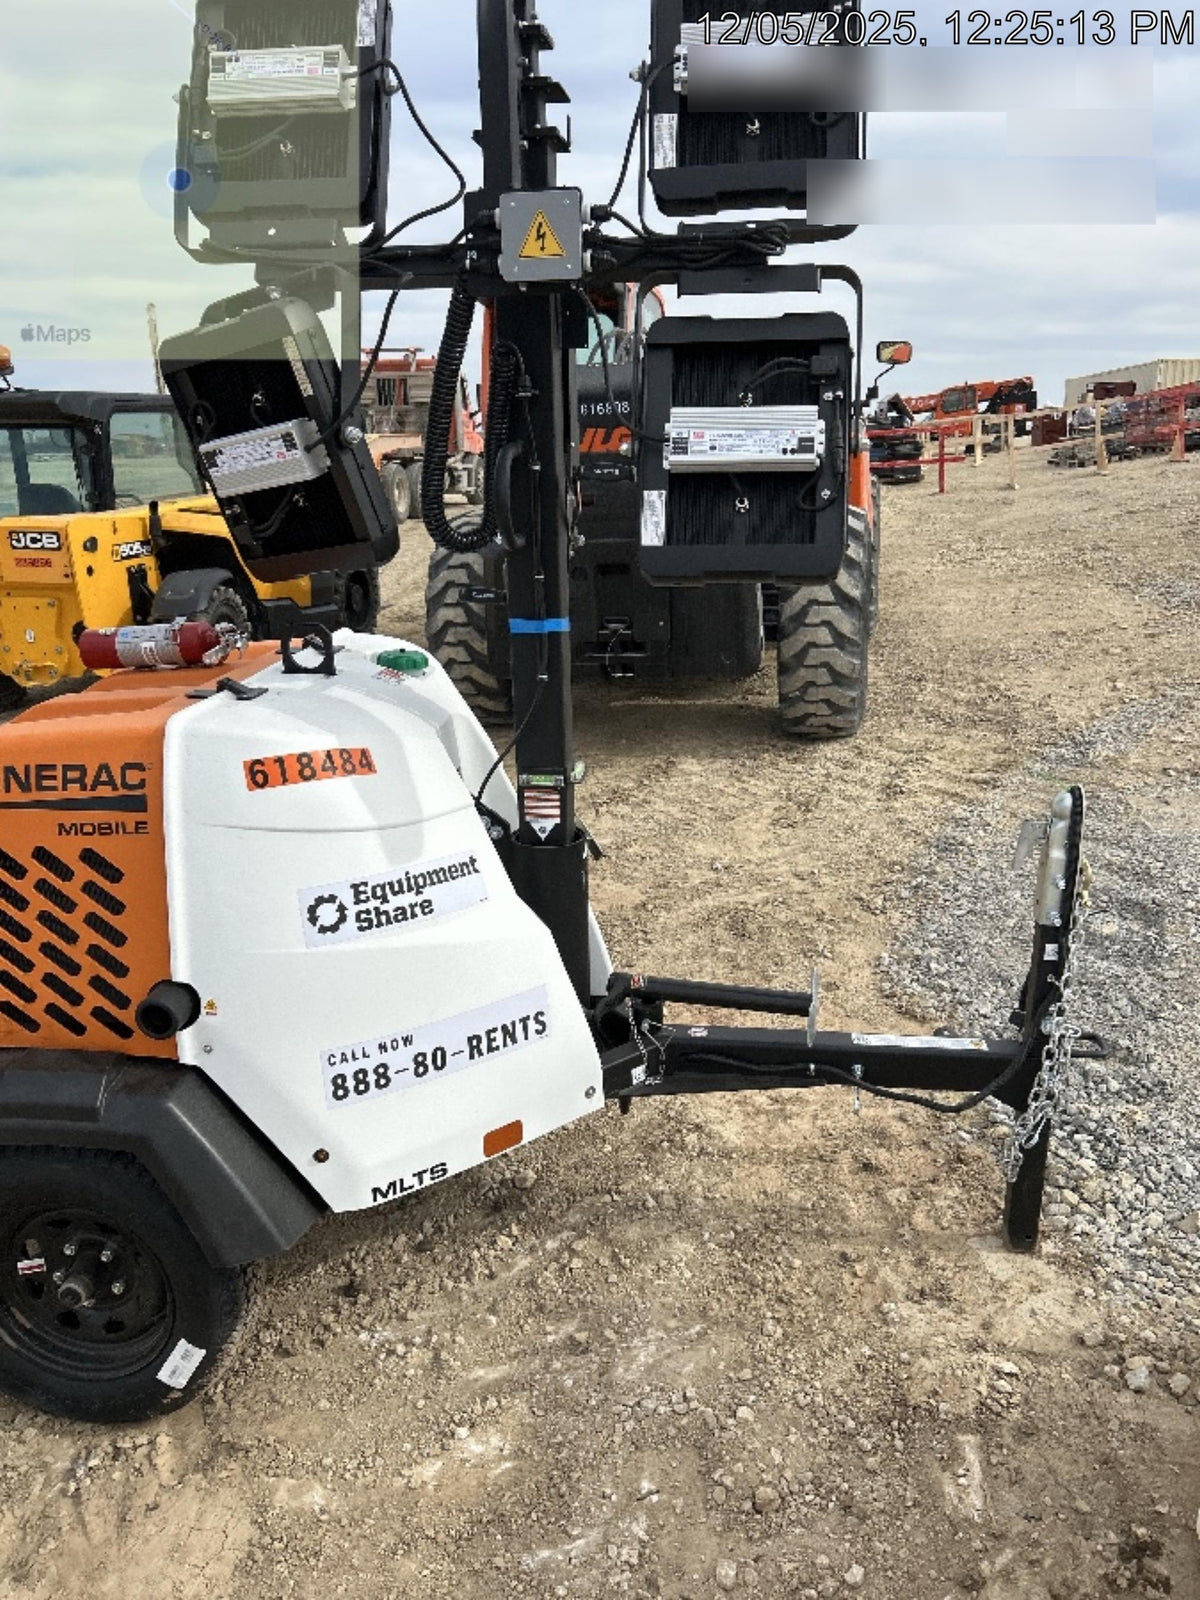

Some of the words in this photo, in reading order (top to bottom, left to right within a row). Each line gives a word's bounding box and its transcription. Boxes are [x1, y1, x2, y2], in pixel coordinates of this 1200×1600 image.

[12, 533, 59, 548] JCB
[249, 748, 377, 789] 618484
[57, 821, 149, 836] MOBILE
[350, 855, 480, 905] Equipment
[355, 898, 434, 932] Share
[328, 1046, 370, 1067] CALL
[377, 1033, 414, 1054] NOW
[331, 1010, 547, 1101] 888-80-RENTS
[371, 1162, 448, 1202] MLTS
